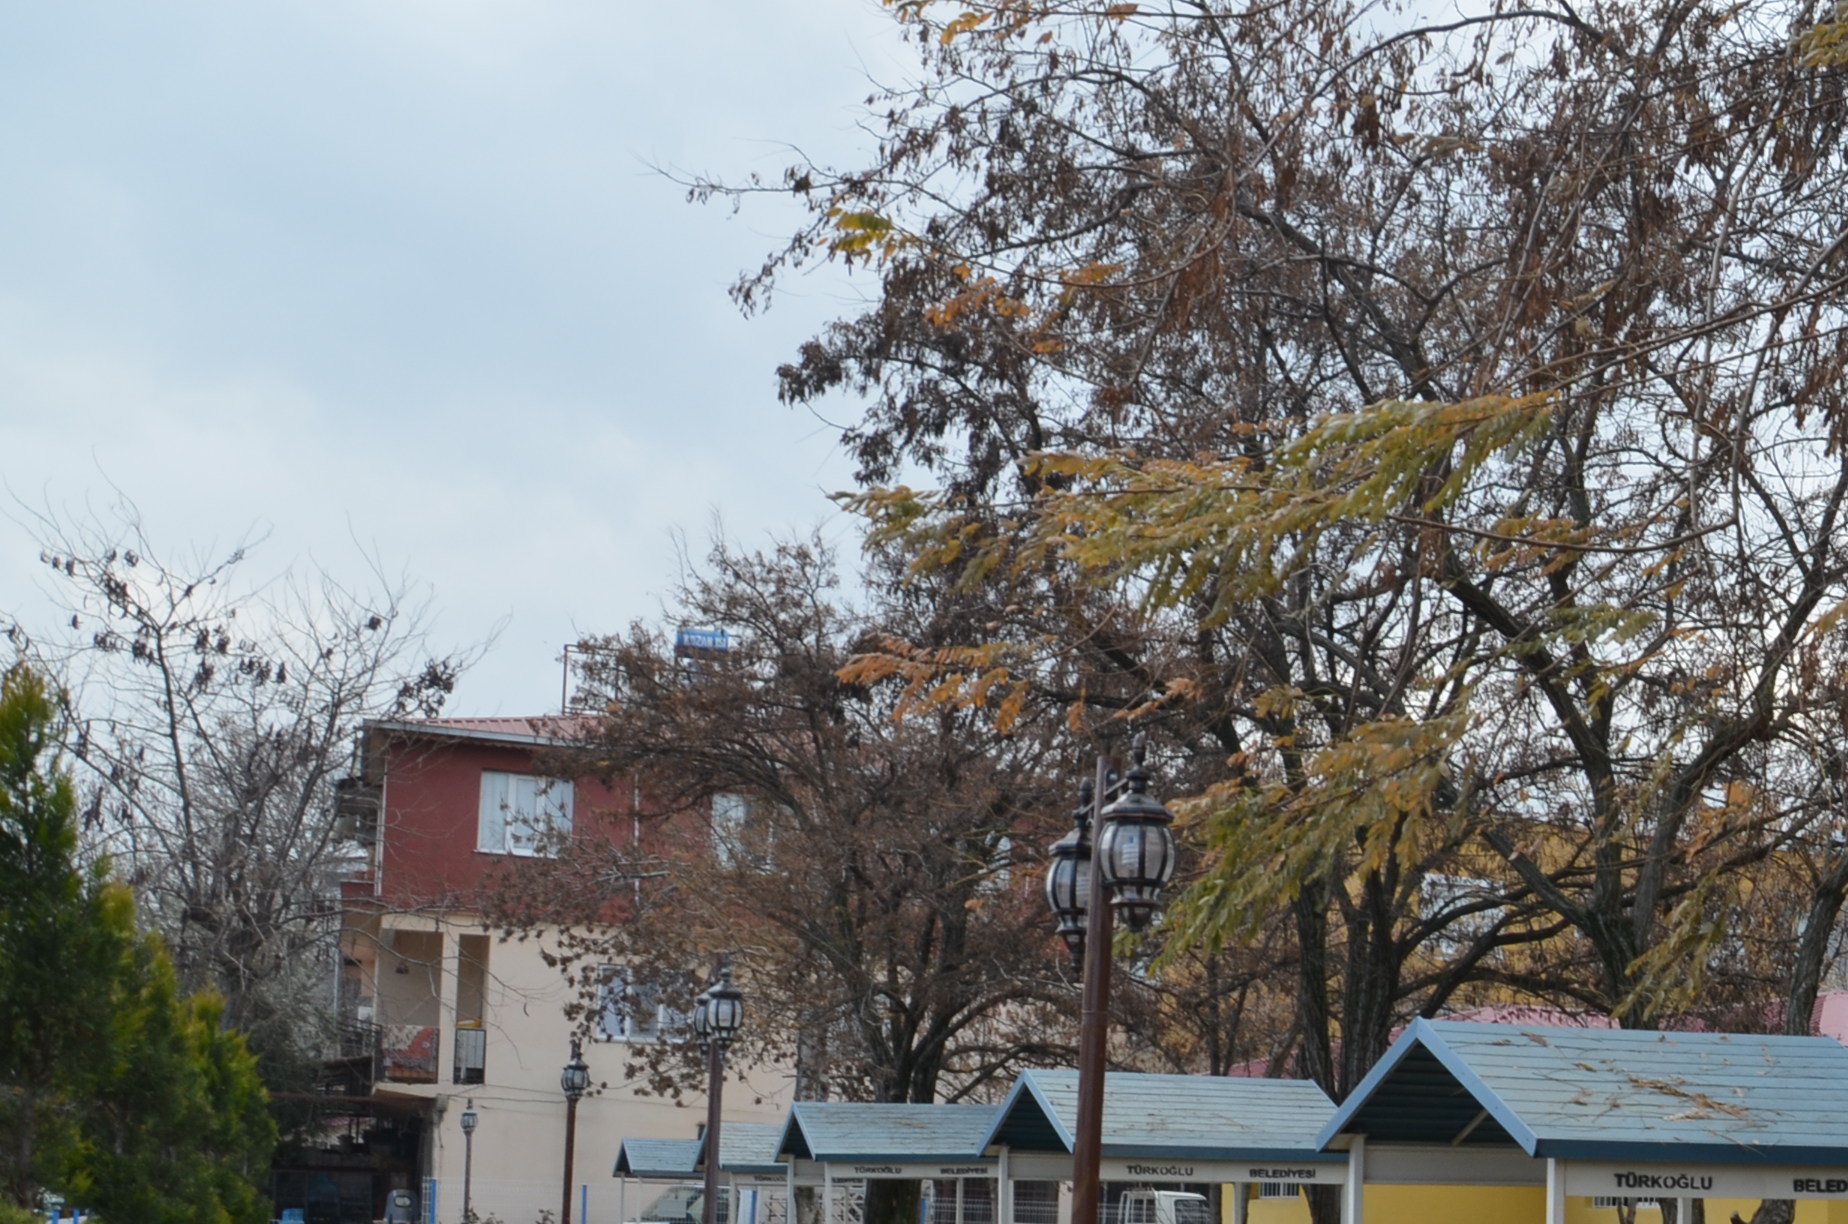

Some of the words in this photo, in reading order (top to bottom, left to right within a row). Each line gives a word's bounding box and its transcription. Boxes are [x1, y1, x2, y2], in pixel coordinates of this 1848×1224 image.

[854, 1166, 902, 1175] TÜRKOĞLU
[940, 1167, 988, 1175] BELEDİYESİ
[1126, 1164, 1194, 1177] TÜRKOĞLU
[1249, 1168, 1316, 1179] BELEDİYESİ
[1614, 1171, 1714, 1191] TÜRKOĞLU
